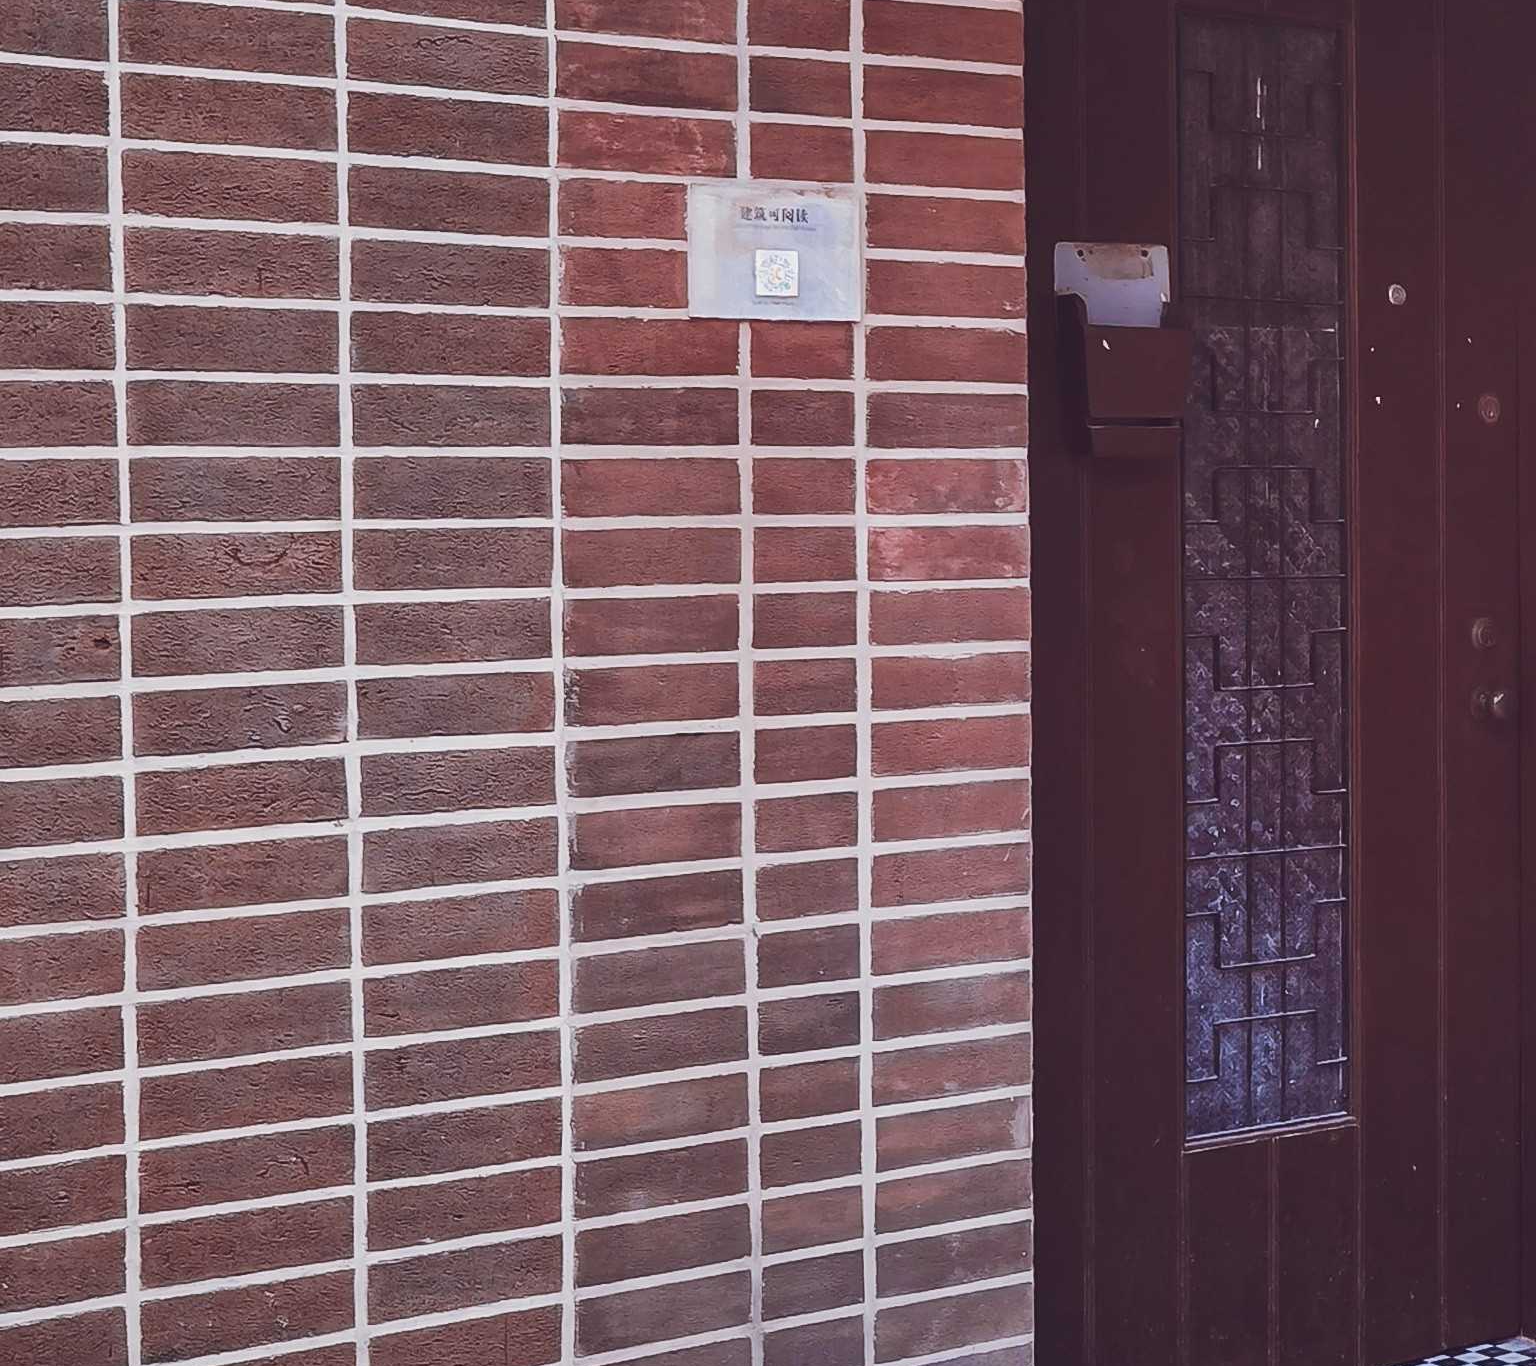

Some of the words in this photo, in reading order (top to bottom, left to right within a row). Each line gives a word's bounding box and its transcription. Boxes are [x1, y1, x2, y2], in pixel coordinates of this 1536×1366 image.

[739, 205, 810, 224] 建筑可阅读
